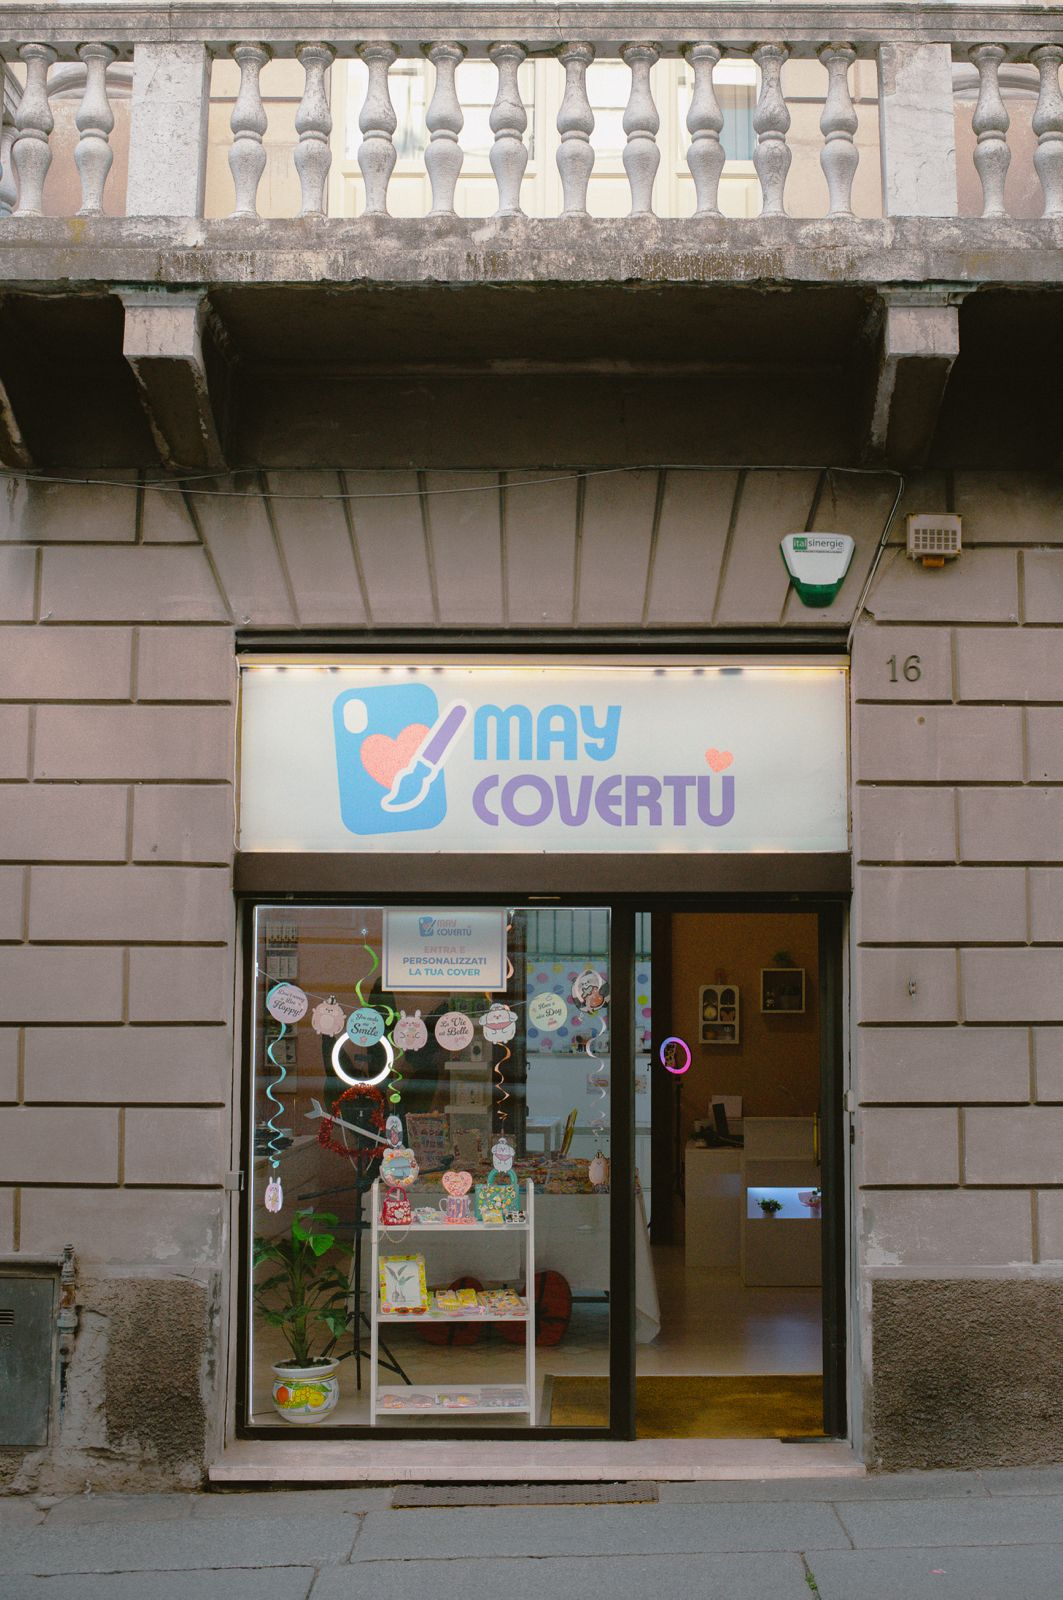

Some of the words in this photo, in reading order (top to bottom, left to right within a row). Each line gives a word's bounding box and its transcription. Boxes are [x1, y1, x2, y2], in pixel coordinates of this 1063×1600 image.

[886, 655, 921, 682] 16
[474, 704, 621, 761] MAY
[424, 946, 456, 954] ENTRA
[460, 946, 466, 954] E
[403, 957, 486, 965] PERSONALIZZATI
[424, 968, 444, 976] TUA
[447, 968, 480, 976] COVER
[451, 1017, 466, 1026] Vie
[351, 1022, 378, 1037] Smile
[447, 1027, 469, 1036] Belle
